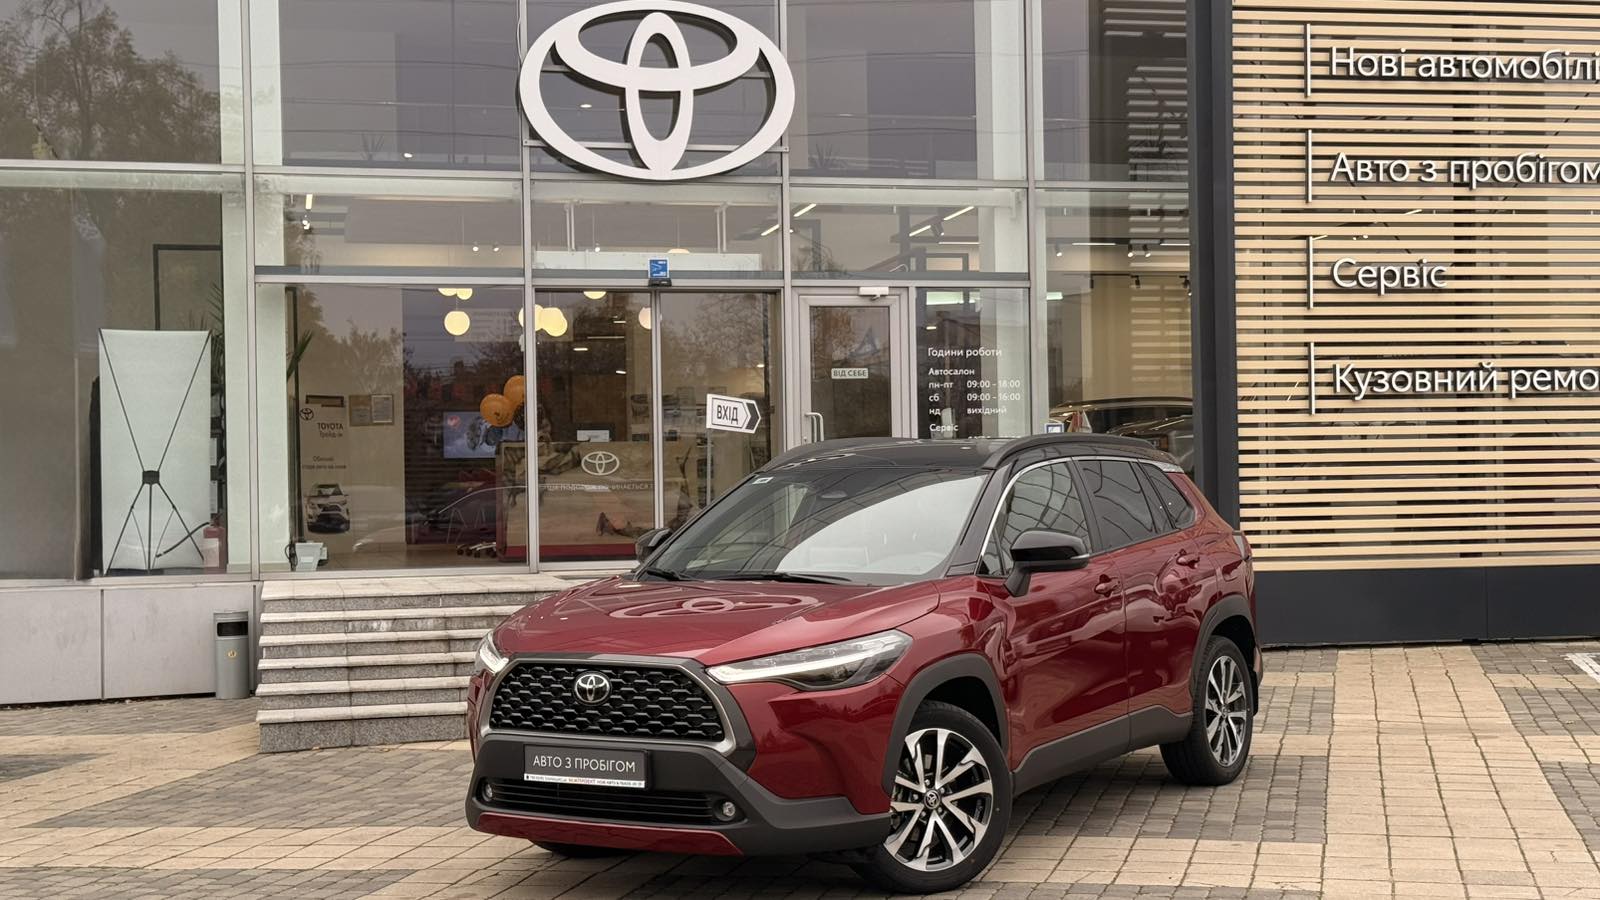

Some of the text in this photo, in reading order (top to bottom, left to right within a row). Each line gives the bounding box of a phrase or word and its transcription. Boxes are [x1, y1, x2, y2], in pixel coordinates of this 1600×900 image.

[1330, 46, 1600, 80] Нові автомобілі
[1330, 152, 1600, 189] Авто з пробігом
[1332, 258, 1449, 295] Сервіс
[927, 347, 1002, 358] Години роботи
[833, 369, 867, 378] ВІД СЕБЕ
[928, 367, 975, 376] Автосалон
[928, 381, 954, 389] пн-пт
[966, 379, 991, 388] 09:00
[1334, 362, 1498, 400] Кузовний
[928, 393, 940, 402] сб
[966, 392, 991, 401] 09:00
[998, 392, 1021, 401] 16:00
[717, 404, 739, 424] ВХІД
[929, 406, 1007, 415] нд вихідний
[317, 422, 344, 430] TOYOTA
[929, 424, 959, 432] Сервіс
[533, 755, 562, 768] АВТО
[574, 758, 636, 772] ПРОБІГОМ
